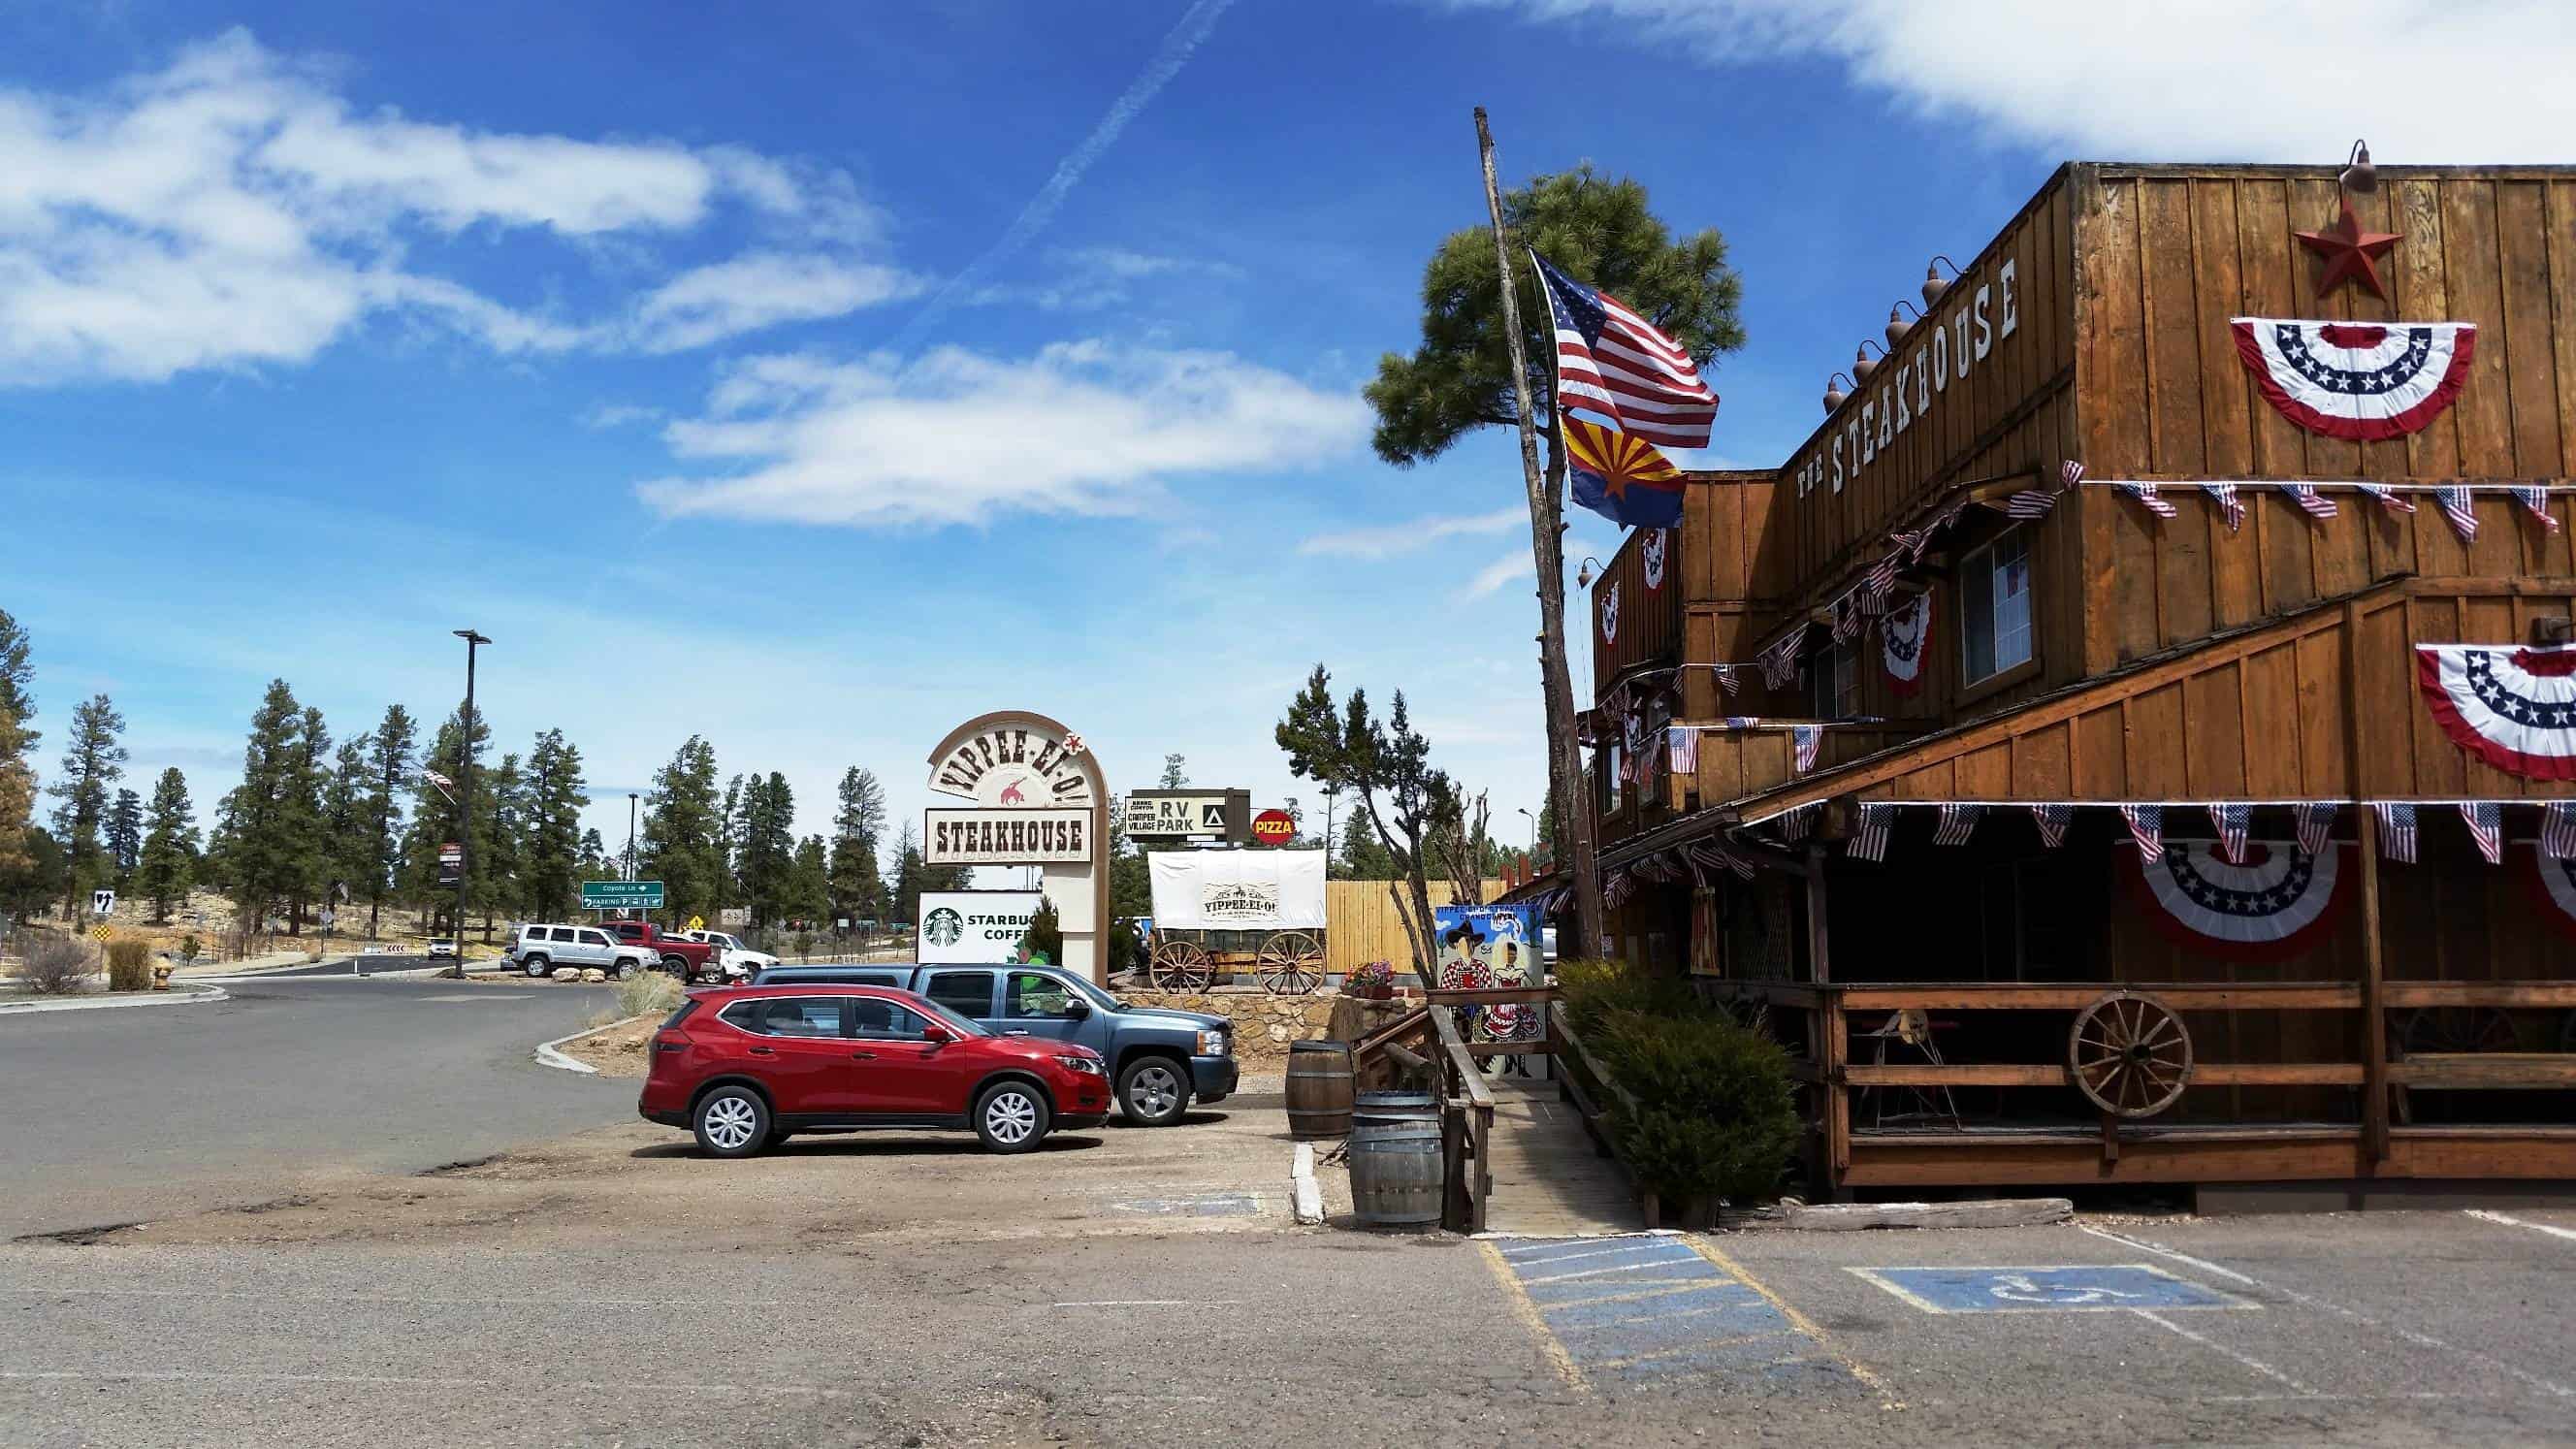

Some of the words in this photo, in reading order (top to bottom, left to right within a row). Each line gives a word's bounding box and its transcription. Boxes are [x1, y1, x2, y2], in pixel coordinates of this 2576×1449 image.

[1797, 453, 1823, 499] THE
[1833, 259, 2017, 496] STEAKHOUSE
[1160, 801, 1189, 818] RV
[1128, 813, 1156, 821] CAMPER
[1128, 821, 1155, 831] VILLAGE
[1156, 819, 1194, 831] PARK
[1255, 820, 1293, 834] PIZZA
[936, 821, 1082, 853] STEAKHOUSE
